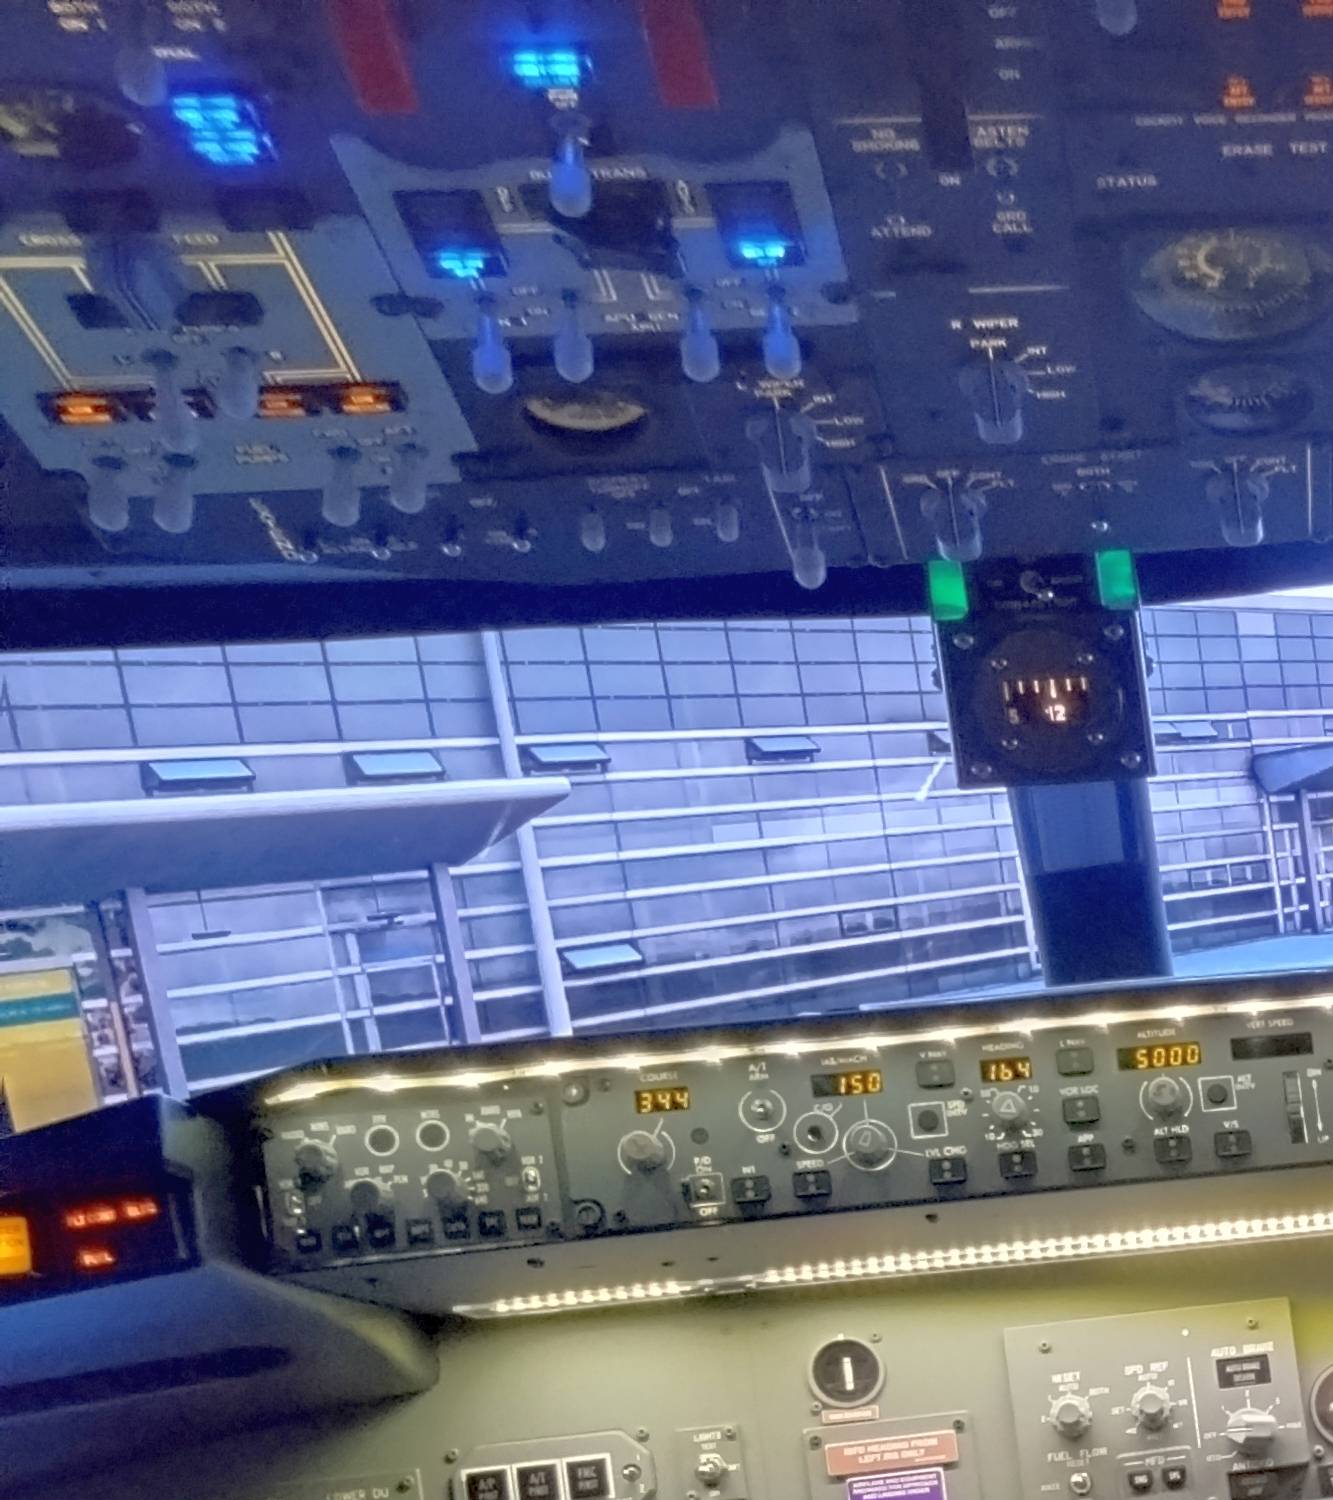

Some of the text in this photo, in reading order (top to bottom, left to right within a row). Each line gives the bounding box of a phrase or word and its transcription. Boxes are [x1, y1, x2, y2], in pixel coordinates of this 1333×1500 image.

[1222, 143, 1273, 157] ERASE
[1290, 141, 1328, 154] TEST
[939, 175, 962, 187] ON
[1096, 175, 1158, 189] STATUS
[870, 225, 933, 239] ATTEND
[992, 222, 1034, 234] CALL
[973, 318, 1019, 329] WIPER
[1268, 1018, 1294, 1027] SPEED
[1136, 1045, 1199, 1069] 5000
[990, 1063, 1030, 1081] 164
[839, 1073, 881, 1094] 150
[640, 1092, 689, 1113] 344
[1154, 1128, 1170, 1136] ALT
[756, 1134, 775, 1143] OFF
[797, 1159, 824, 1168] SPEED
[700, 1207, 717, 1216] OFF
[1047, 1447, 1108, 1462] FUEL FLOW
[373, 1488, 389, 1499] DU
